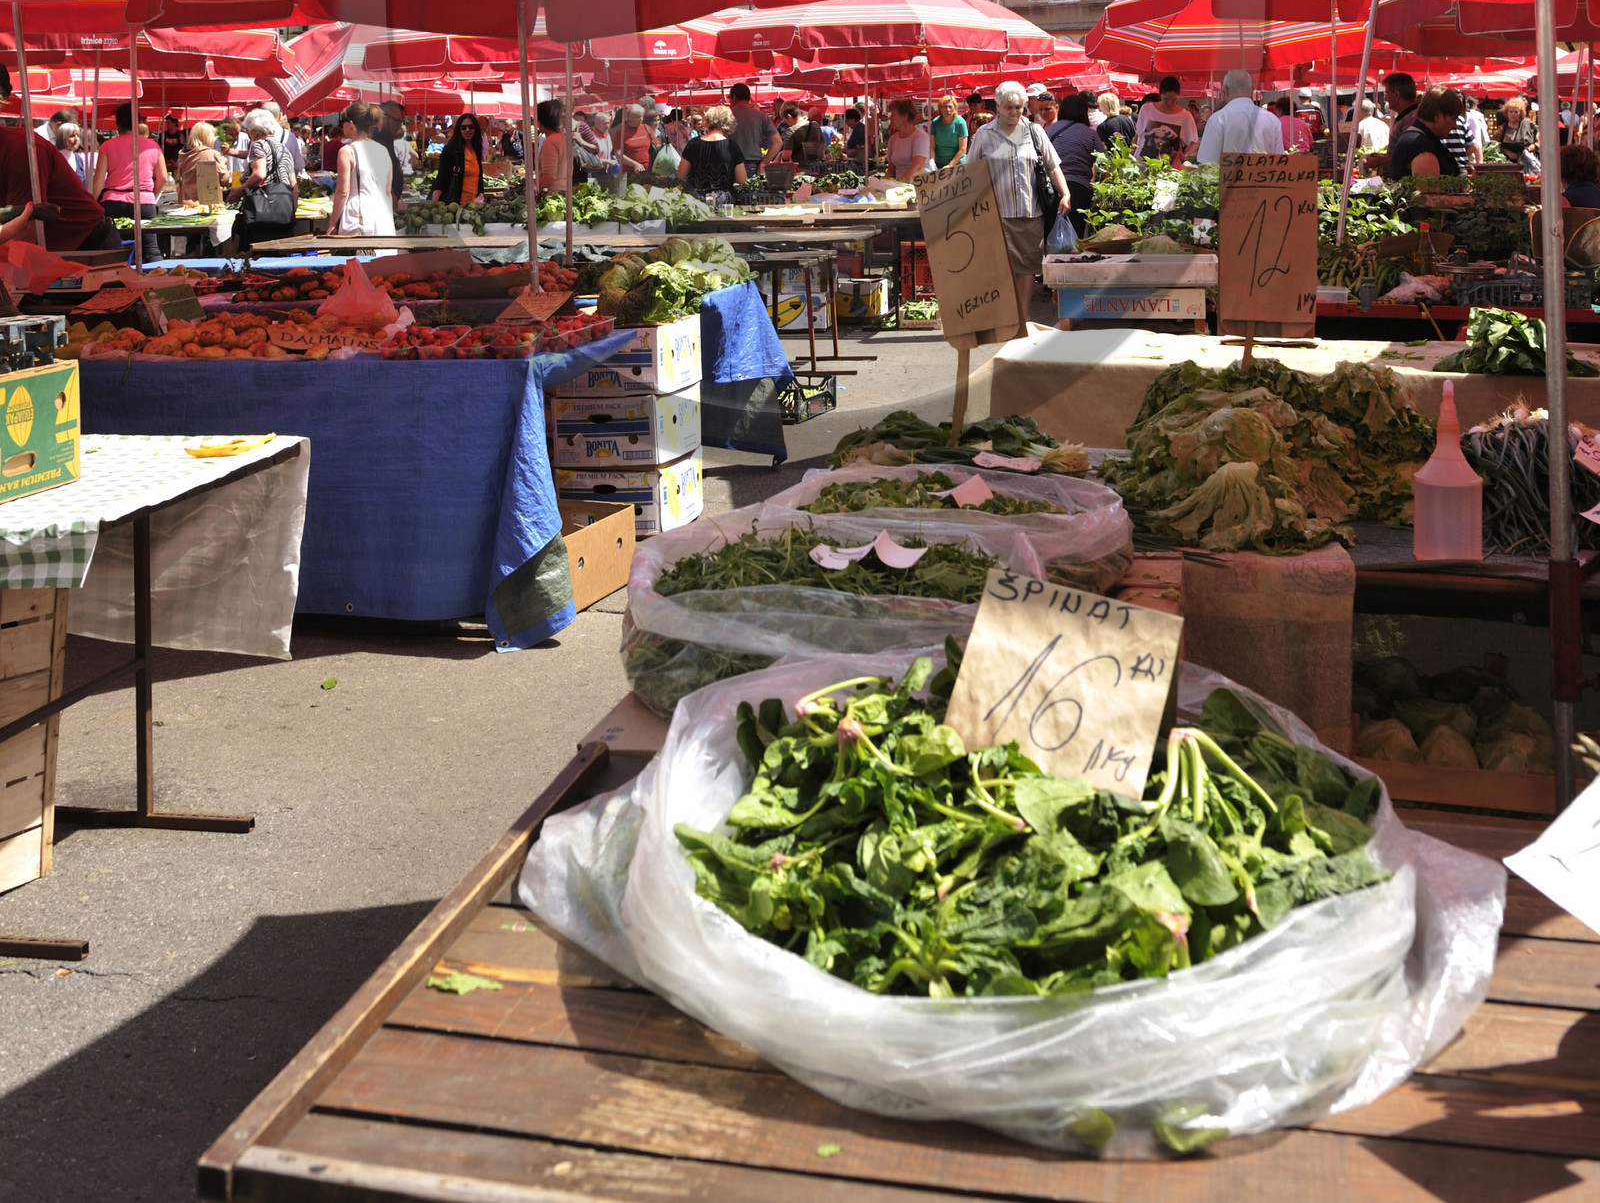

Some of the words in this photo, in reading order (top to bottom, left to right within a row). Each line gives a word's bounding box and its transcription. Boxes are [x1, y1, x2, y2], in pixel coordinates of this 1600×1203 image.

[1220, 154, 1289, 167] SALATA
[1222, 169, 1316, 183] KRISTALKA
[919, 177, 972, 206] BLITVA
[945, 207, 975, 273] 5
[971, 201, 990, 222] KN
[1238, 194, 1293, 297] 12
[1084, 298, 1171, 313] L'AMANTE
[588, 371, 622, 388] BONITA
[573, 403, 604, 412] PREMIUM
[605, 402, 622, 410] PACK
[586, 440, 621, 458] BONITA
[20, 467, 62, 487] PREMIUM
[576, 472, 607, 480] PREMIUM
[987, 569, 1143, 629] ŠPINAT
[983, 633, 1121, 751] 16
